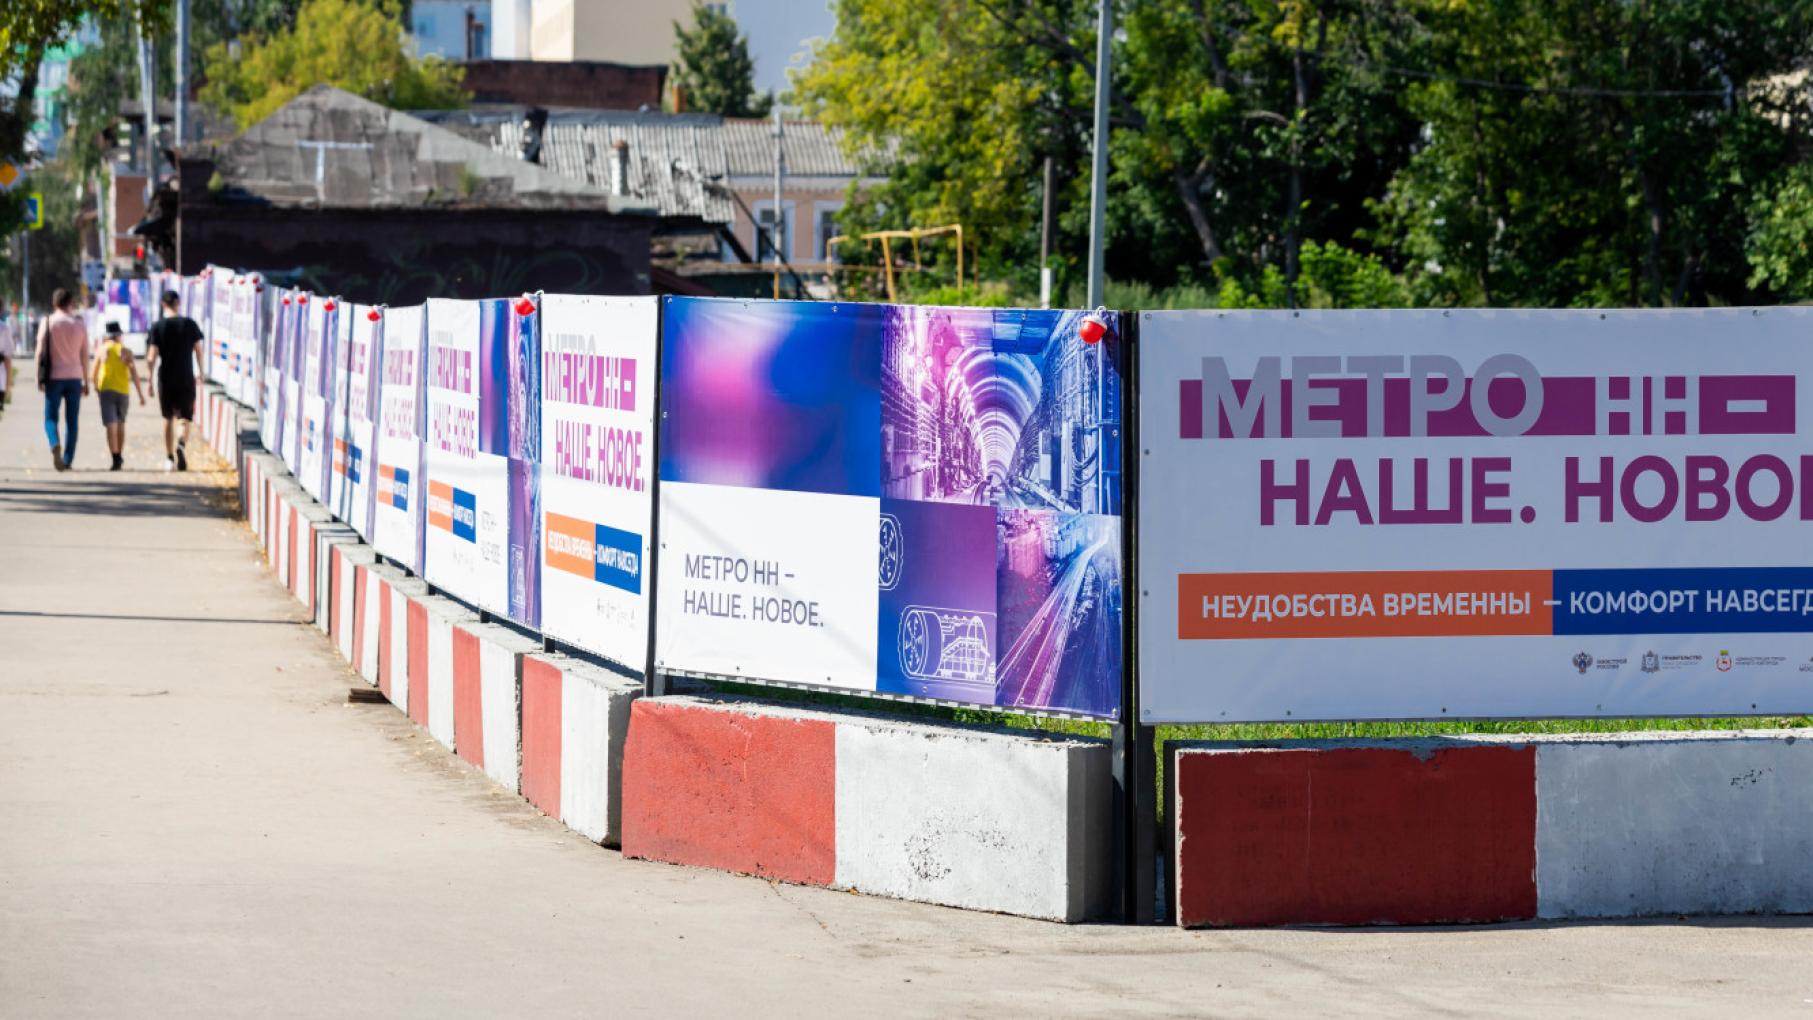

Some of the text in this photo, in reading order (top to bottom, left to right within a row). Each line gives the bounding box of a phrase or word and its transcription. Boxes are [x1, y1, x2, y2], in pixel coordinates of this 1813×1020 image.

[548, 333, 598, 406] МЕТРО
[603, 356, 621, 410] НН
[1202, 353, 1545, 438] МЕТРО
[1595, 376, 1700, 436] НН
[555, 419, 644, 493] НАШЕ. НОВОЕ.
[1260, 455, 1537, 526] НАШЕ.
[685, 553, 749, 583] МЕТРО
[754, 560, 779, 586] НН
[684, 589, 824, 628] НАШЕ. НОВОЕ.
[1202, 593, 1376, 622] НЕУДОБСТВА
[1383, 590, 1531, 616] ВРЕМЕННЫ
[1570, 589, 1699, 615] КОМФОРТ
